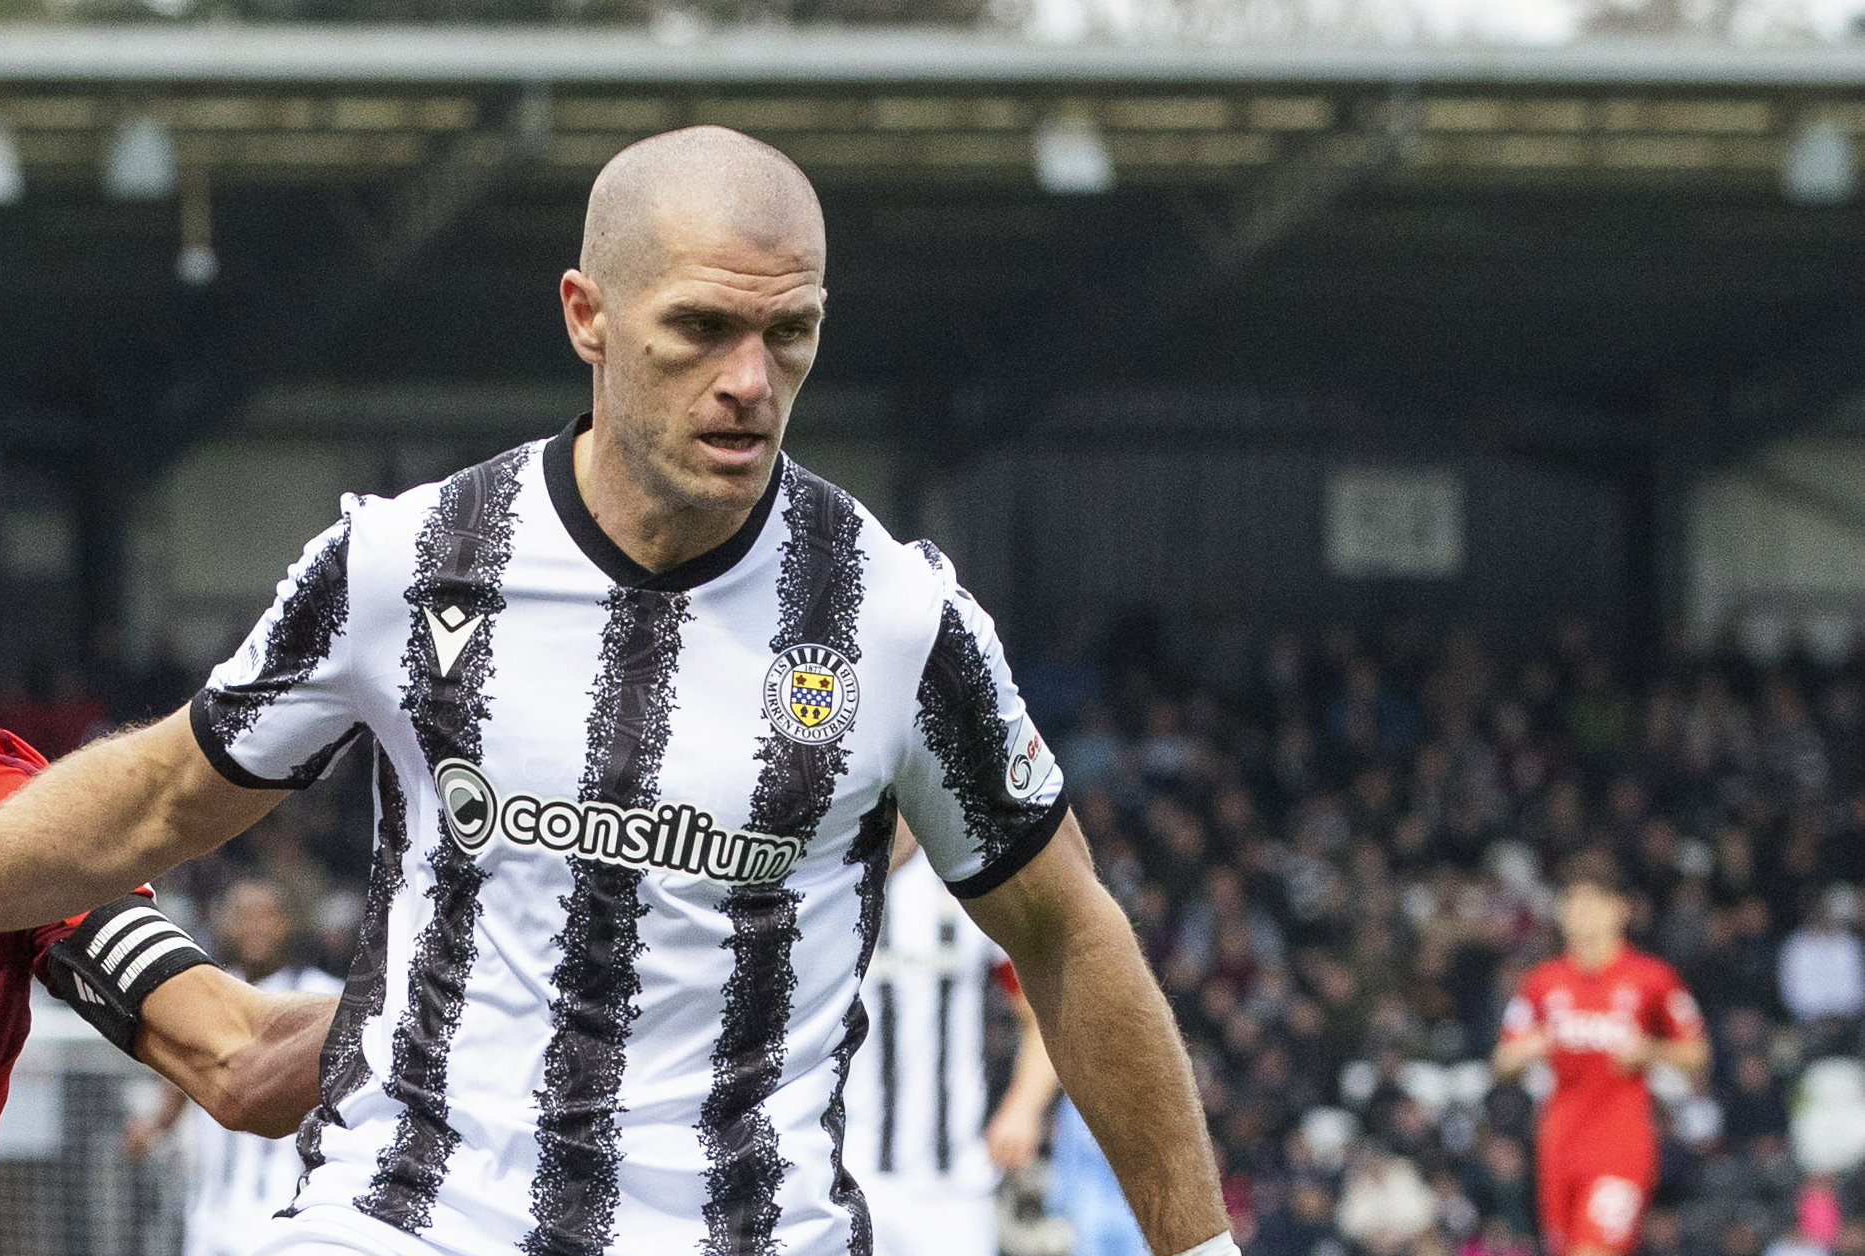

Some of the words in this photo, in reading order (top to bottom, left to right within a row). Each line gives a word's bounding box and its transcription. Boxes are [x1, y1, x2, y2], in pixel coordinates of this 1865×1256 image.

[767, 681, 794, 730] MIRREN
[794, 705, 854, 739] FOOTBALL
[839, 668, 856, 703] CLUB
[501, 797, 798, 882] consilium
